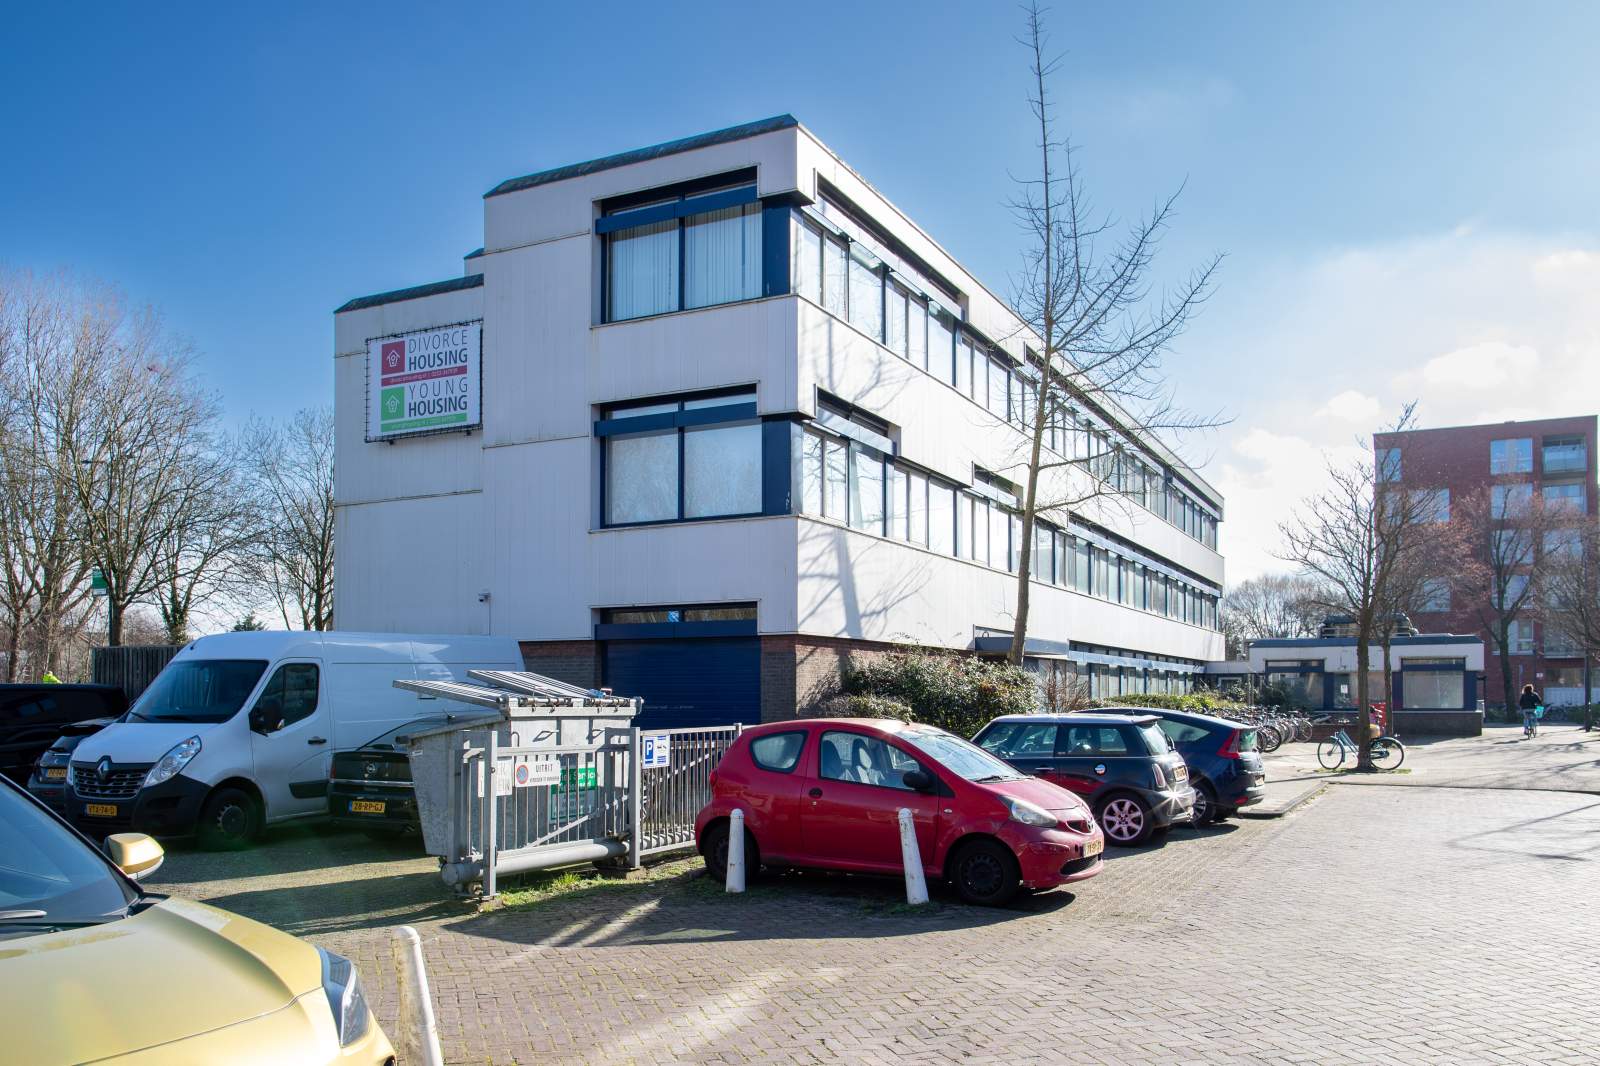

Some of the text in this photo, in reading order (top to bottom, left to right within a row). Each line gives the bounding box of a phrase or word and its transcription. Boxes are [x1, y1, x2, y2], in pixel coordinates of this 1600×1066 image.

[408, 329, 468, 354] DIVORCE
[408, 348, 468, 371] HOUSING
[408, 377, 468, 400] YOUNG
[408, 395, 468, 417] HOUSING
[535, 763, 553, 773] UITRIT
